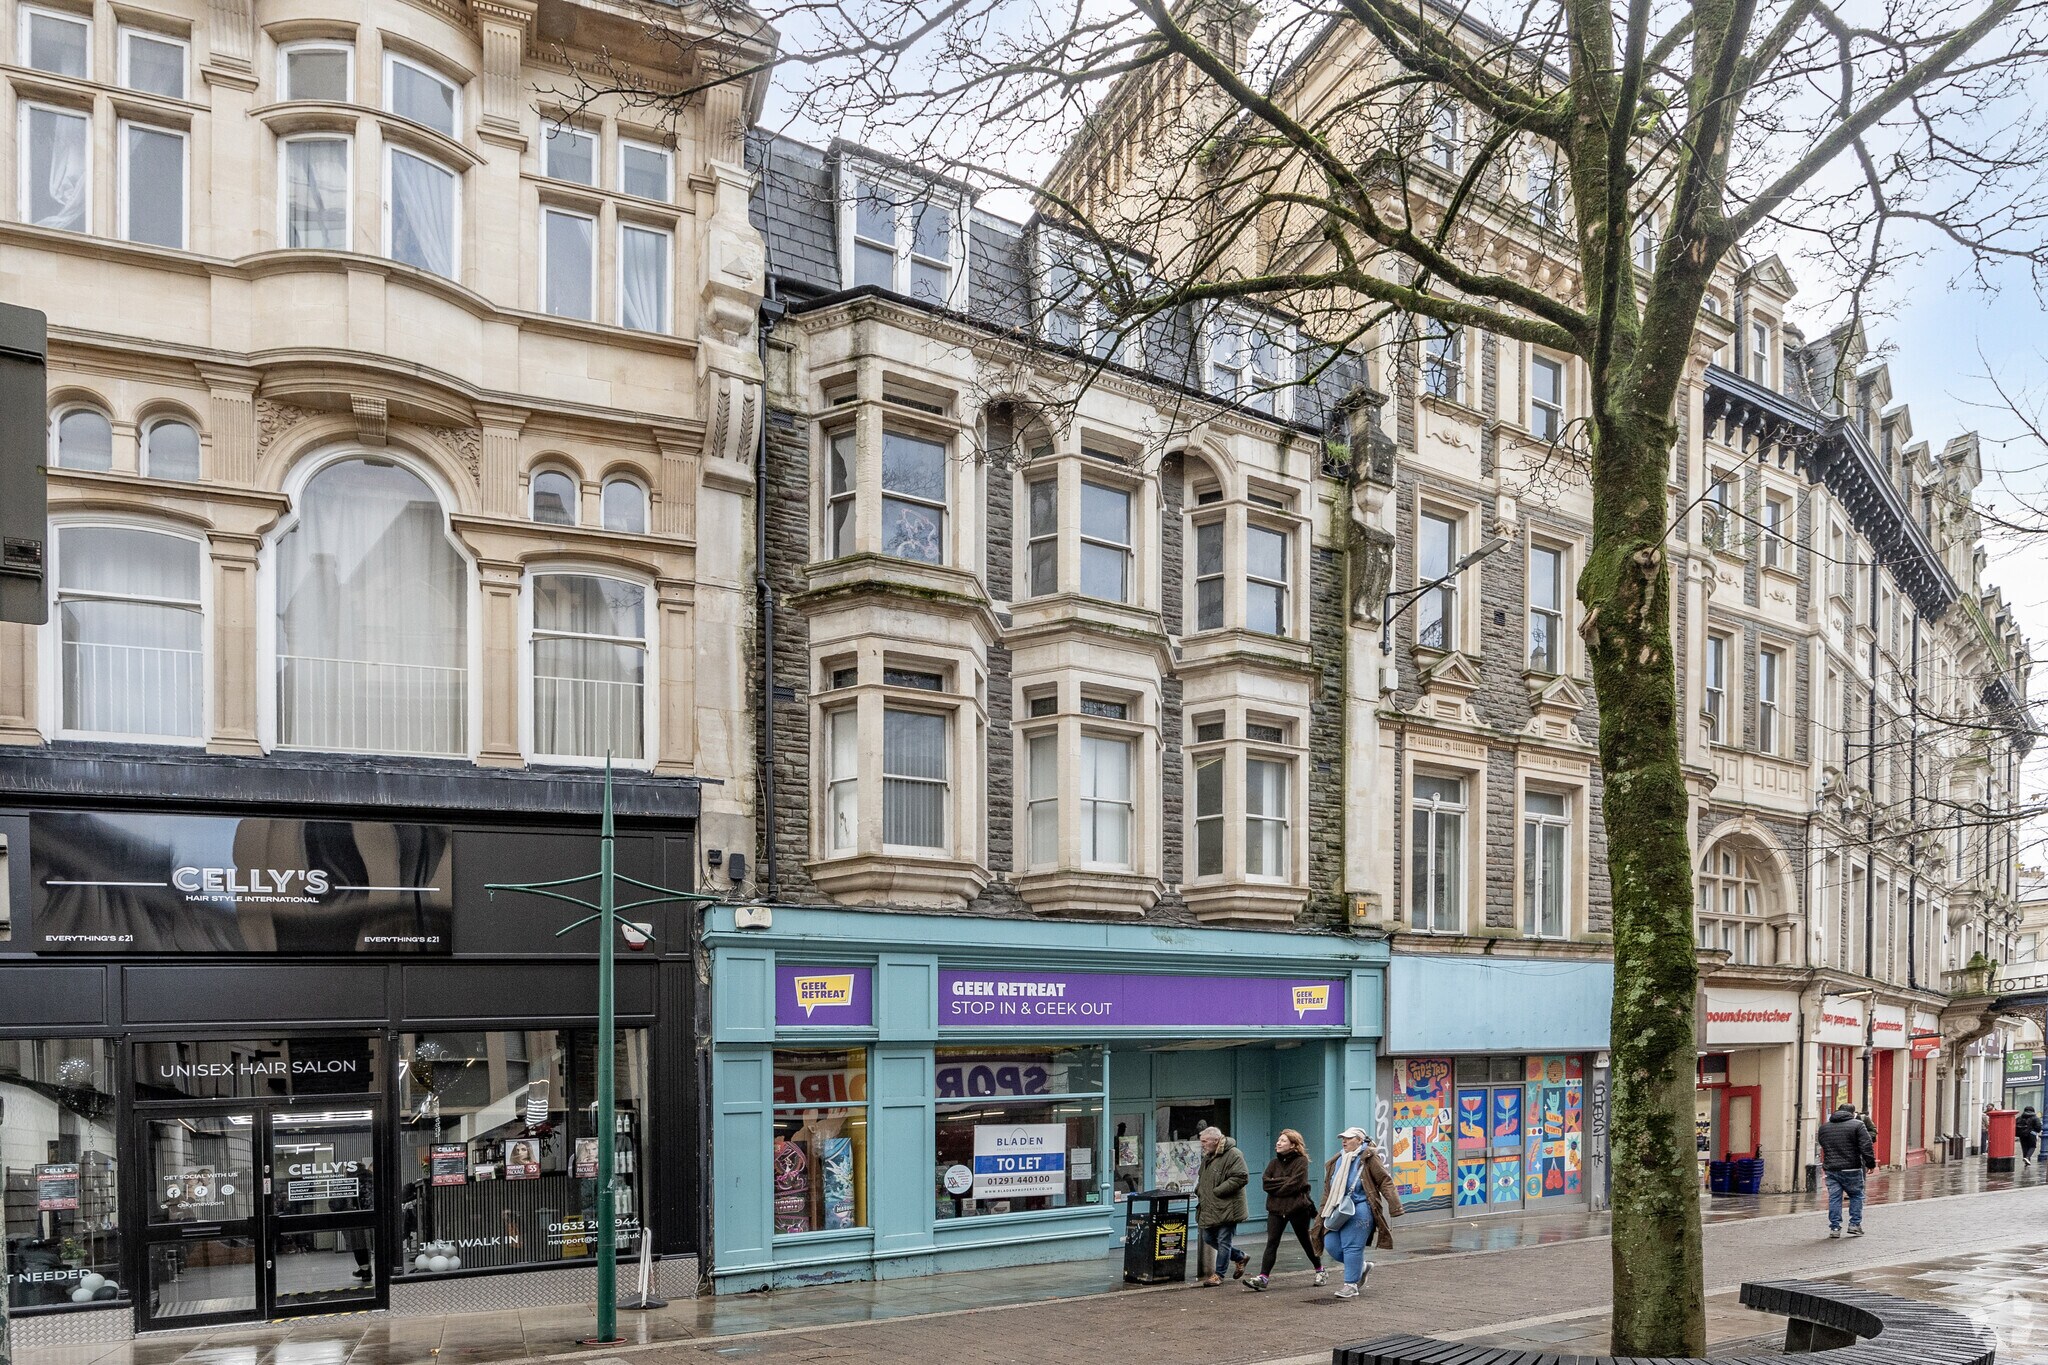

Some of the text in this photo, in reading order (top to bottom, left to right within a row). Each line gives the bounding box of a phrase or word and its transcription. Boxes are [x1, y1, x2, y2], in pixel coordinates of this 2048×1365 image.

[172, 866, 329, 896] CELLY'S
[186, 894, 209, 902] HAIR
[245, 896, 319, 904] INTERNATIONAL
[46, 934, 134, 942] EVERYTHING'S £21
[801, 982, 827, 990] GEEK
[952, 981, 1066, 996] GEEK RETREAT
[1992, 975, 2048, 993] HOTE
[802, 990, 846, 998] RETREAT
[952, 1001, 1112, 1015] STOP IN & GEEK OUT
[161, 1060, 356, 1077] UNISEX HAIR SALON
[997, 1137, 1043, 1146] BLADEN
[288, 1160, 358, 1176] CELLY'S
[997, 1157, 1042, 1171] TO LET
[987, 1175, 1050, 1186] 01291 440100
[548, 1217, 640, 1232] 01633 2944
[458, 1236, 500, 1248] WALK
[505, 1235, 519, 1245] IN
[548, 1232, 641, 1246] newport@c.co.uk
[19, 1269, 91, 1283] NEEDED
